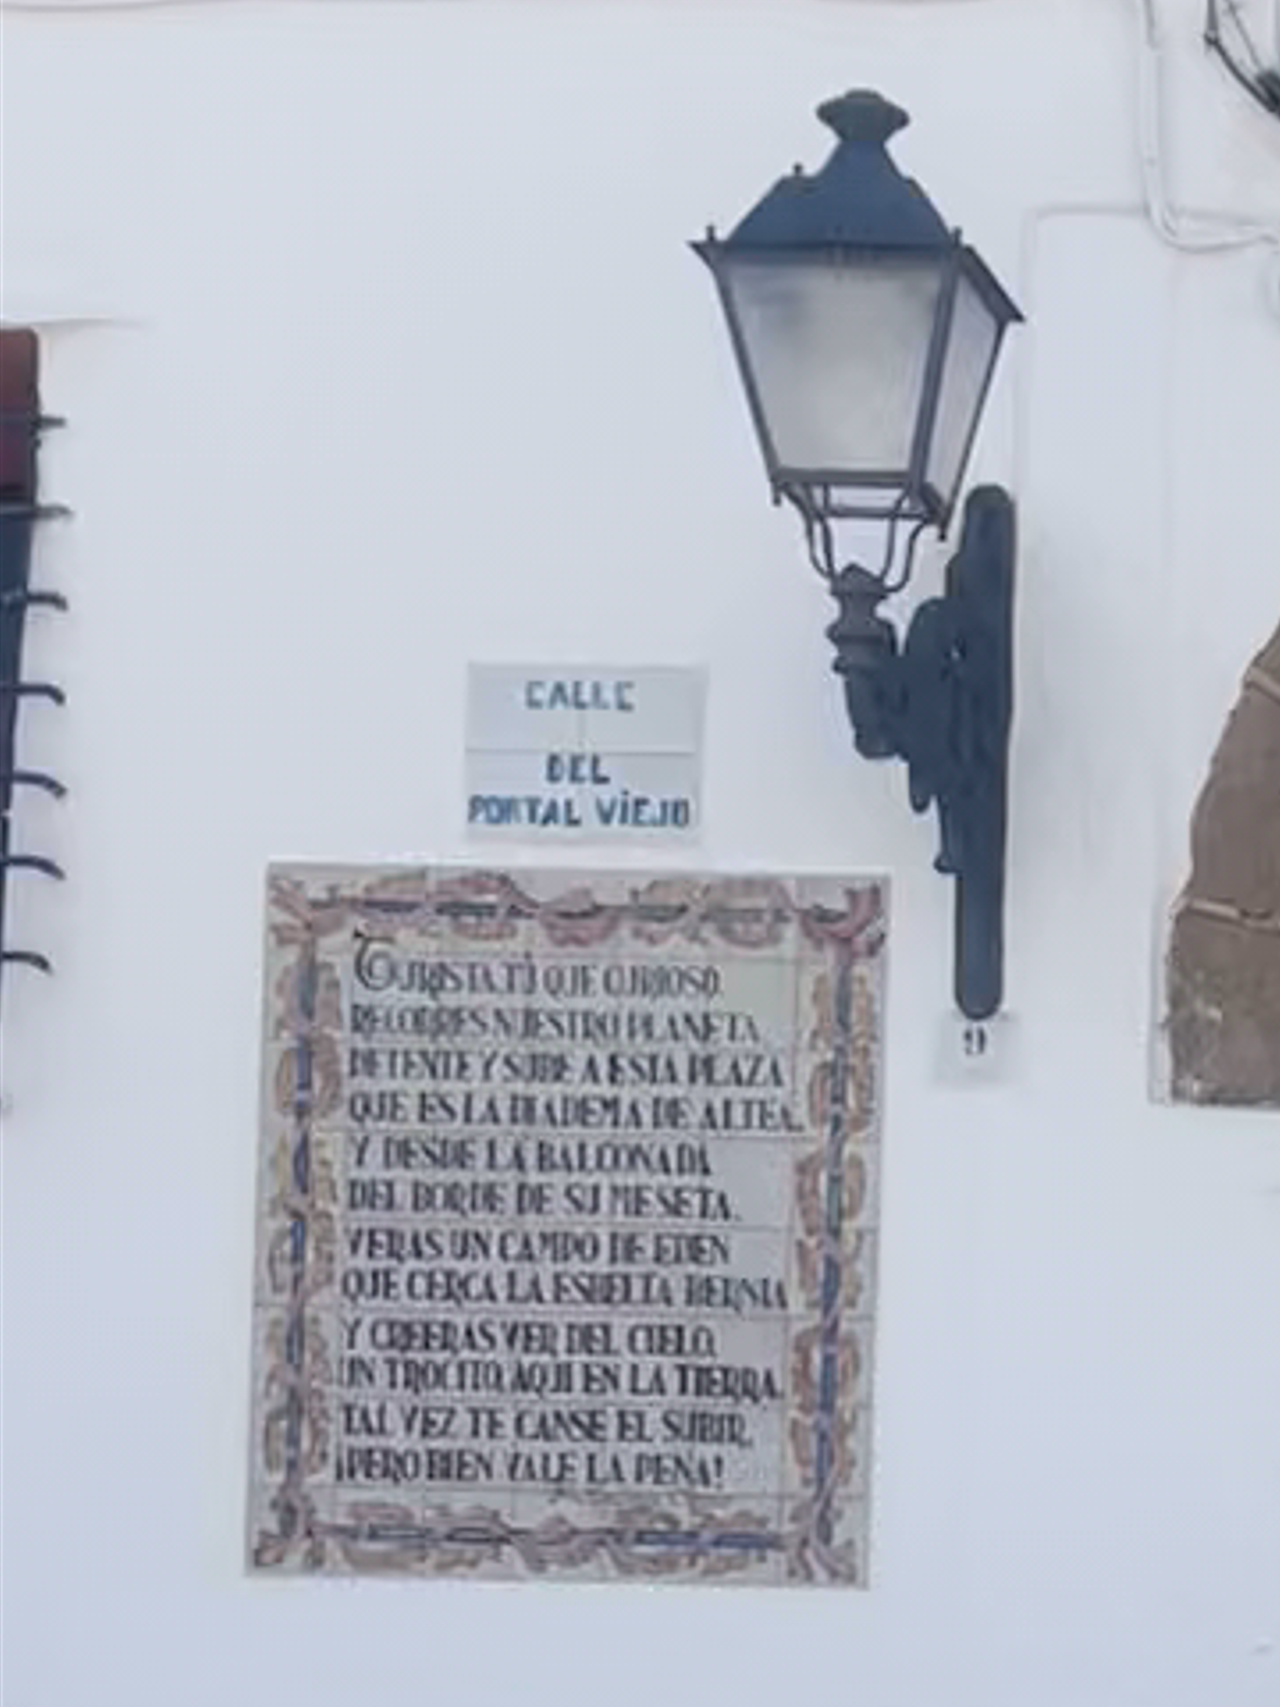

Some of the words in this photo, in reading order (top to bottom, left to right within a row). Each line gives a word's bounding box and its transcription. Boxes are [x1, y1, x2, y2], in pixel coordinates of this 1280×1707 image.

[524, 680, 635, 713] CALLE
[545, 751, 611, 785] DEL
[467, 794, 582, 827] PORTAL
[542, 964, 597, 999] QUE
[351, 1004, 488, 1039] RECORRES
[493, 1007, 621, 1044] NUESTRO
[962, 1025, 988, 1056] 9
[350, 1048, 470, 1082] DETENTE
[480, 1050, 499, 1082] Y
[502, 1053, 571, 1084] SUBE
[580, 1053, 600, 1086] A
[608, 1053, 679, 1086] ESTA
[687, 1054, 785, 1088] PLAZA
[350, 1091, 408, 1127] QUE
[417, 1091, 458, 1124] ES
[463, 1092, 500, 1125] LA
[509, 1094, 643, 1128] DIADEMA
[651, 1095, 696, 1130] DE
[350, 1135, 369, 1169] Y
[383, 1136, 476, 1170] DESDE
[486, 1138, 527, 1173] LA
[537, 1140, 712, 1176] BALCONADA
[348, 1179, 400, 1211] DEL
[411, 1180, 506, 1217] BORDE
[516, 1181, 555, 1215] DE
[563, 1183, 601, 1216] SU
[450, 1227, 493, 1262] UN
[498, 1230, 600, 1264] CAMPO
[608, 1231, 648, 1265] DE
[341, 1268, 400, 1304] QUE
[405, 1268, 499, 1307] CERCA
[505, 1269, 546, 1305] LA
[552, 1271, 674, 1308] ESBELTA
[340, 1316, 363, 1351] Y
[501, 1320, 559, 1356] VER
[565, 1322, 621, 1356] DEL
[338, 1356, 377, 1389] UN
[582, 1363, 622, 1395] EN
[628, 1363, 667, 1397] LA
[342, 1402, 391, 1437] TAL
[402, 1405, 457, 1439] VEZ
[465, 1406, 505, 1440] TE
[513, 1407, 607, 1443] CANSE
[615, 1409, 654, 1443] EL
[425, 1448, 495, 1483] BIEN
[504, 1450, 577, 1484] VALE
[585, 1451, 627, 1485] LA
